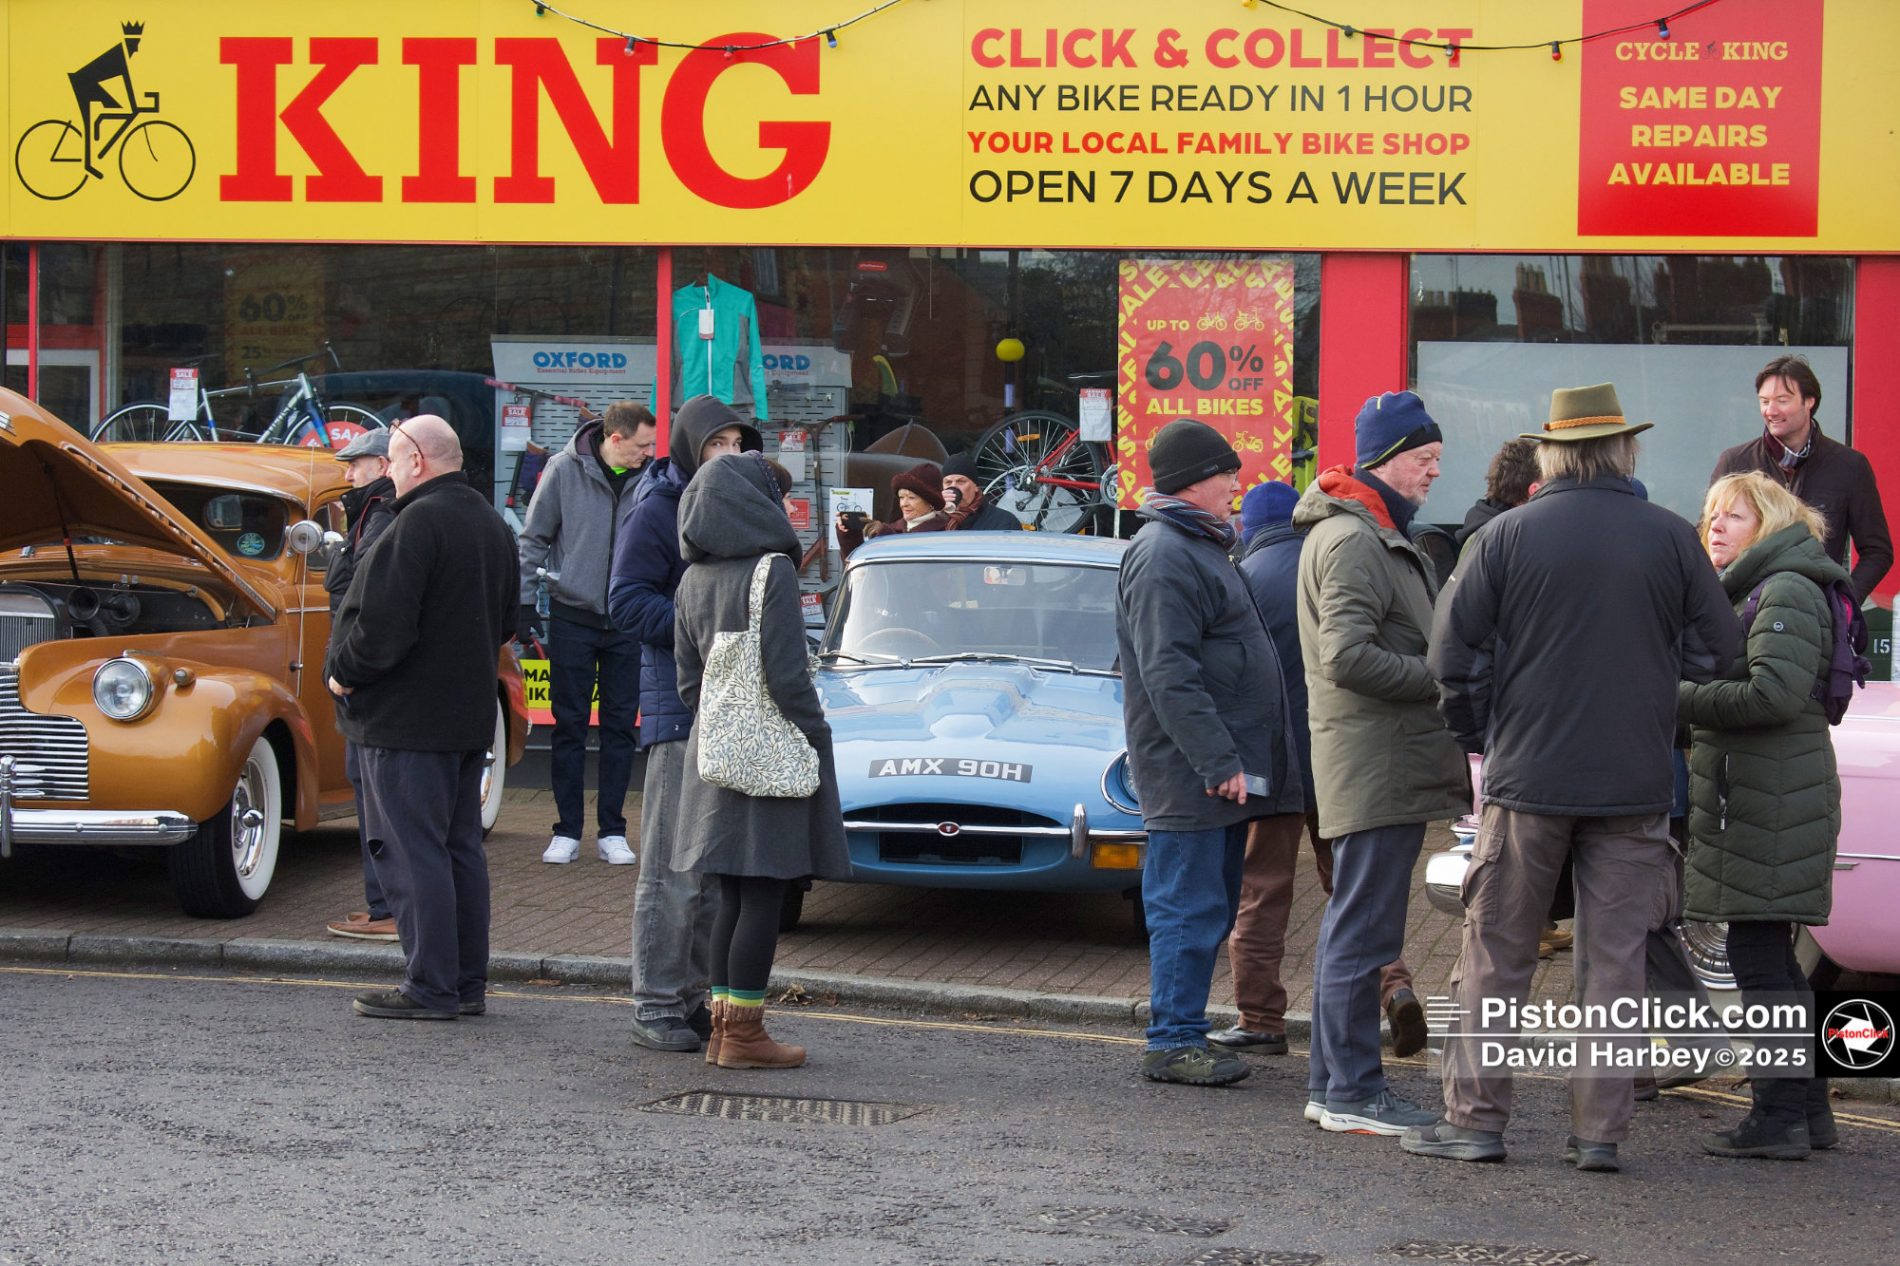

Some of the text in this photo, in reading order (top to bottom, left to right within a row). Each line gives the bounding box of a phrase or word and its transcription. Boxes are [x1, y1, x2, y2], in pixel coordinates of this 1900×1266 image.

[971, 28, 1473, 70] CLICK & COLLECT
[1615, 41, 1788, 61] CYCLE KING
[968, 84, 1473, 113] ANY BIKE READY IN 1 HOUR
[1619, 86, 1783, 109] SAME DAY
[219, 31, 832, 210] KING
[967, 131, 1470, 156] YOUR LOCAL FAMILY BIKE SHOP
[1631, 124, 1768, 148] REPAIRS
[1607, 162, 1790, 186] AVAILABLE
[969, 169, 1467, 206] OPEN 7 DAYS A WEEK
[1147, 319, 1190, 331] UP TO
[533, 351, 627, 369] OXFORD
[761, 353, 811, 371] ORD
[1145, 340, 1264, 391] 60%
[1228, 377, 1264, 391] OFF
[1145, 397, 1264, 416] ALL BIKES
[524, 669, 551, 683] MA
[878, 758, 1023, 781] AMX 90H
